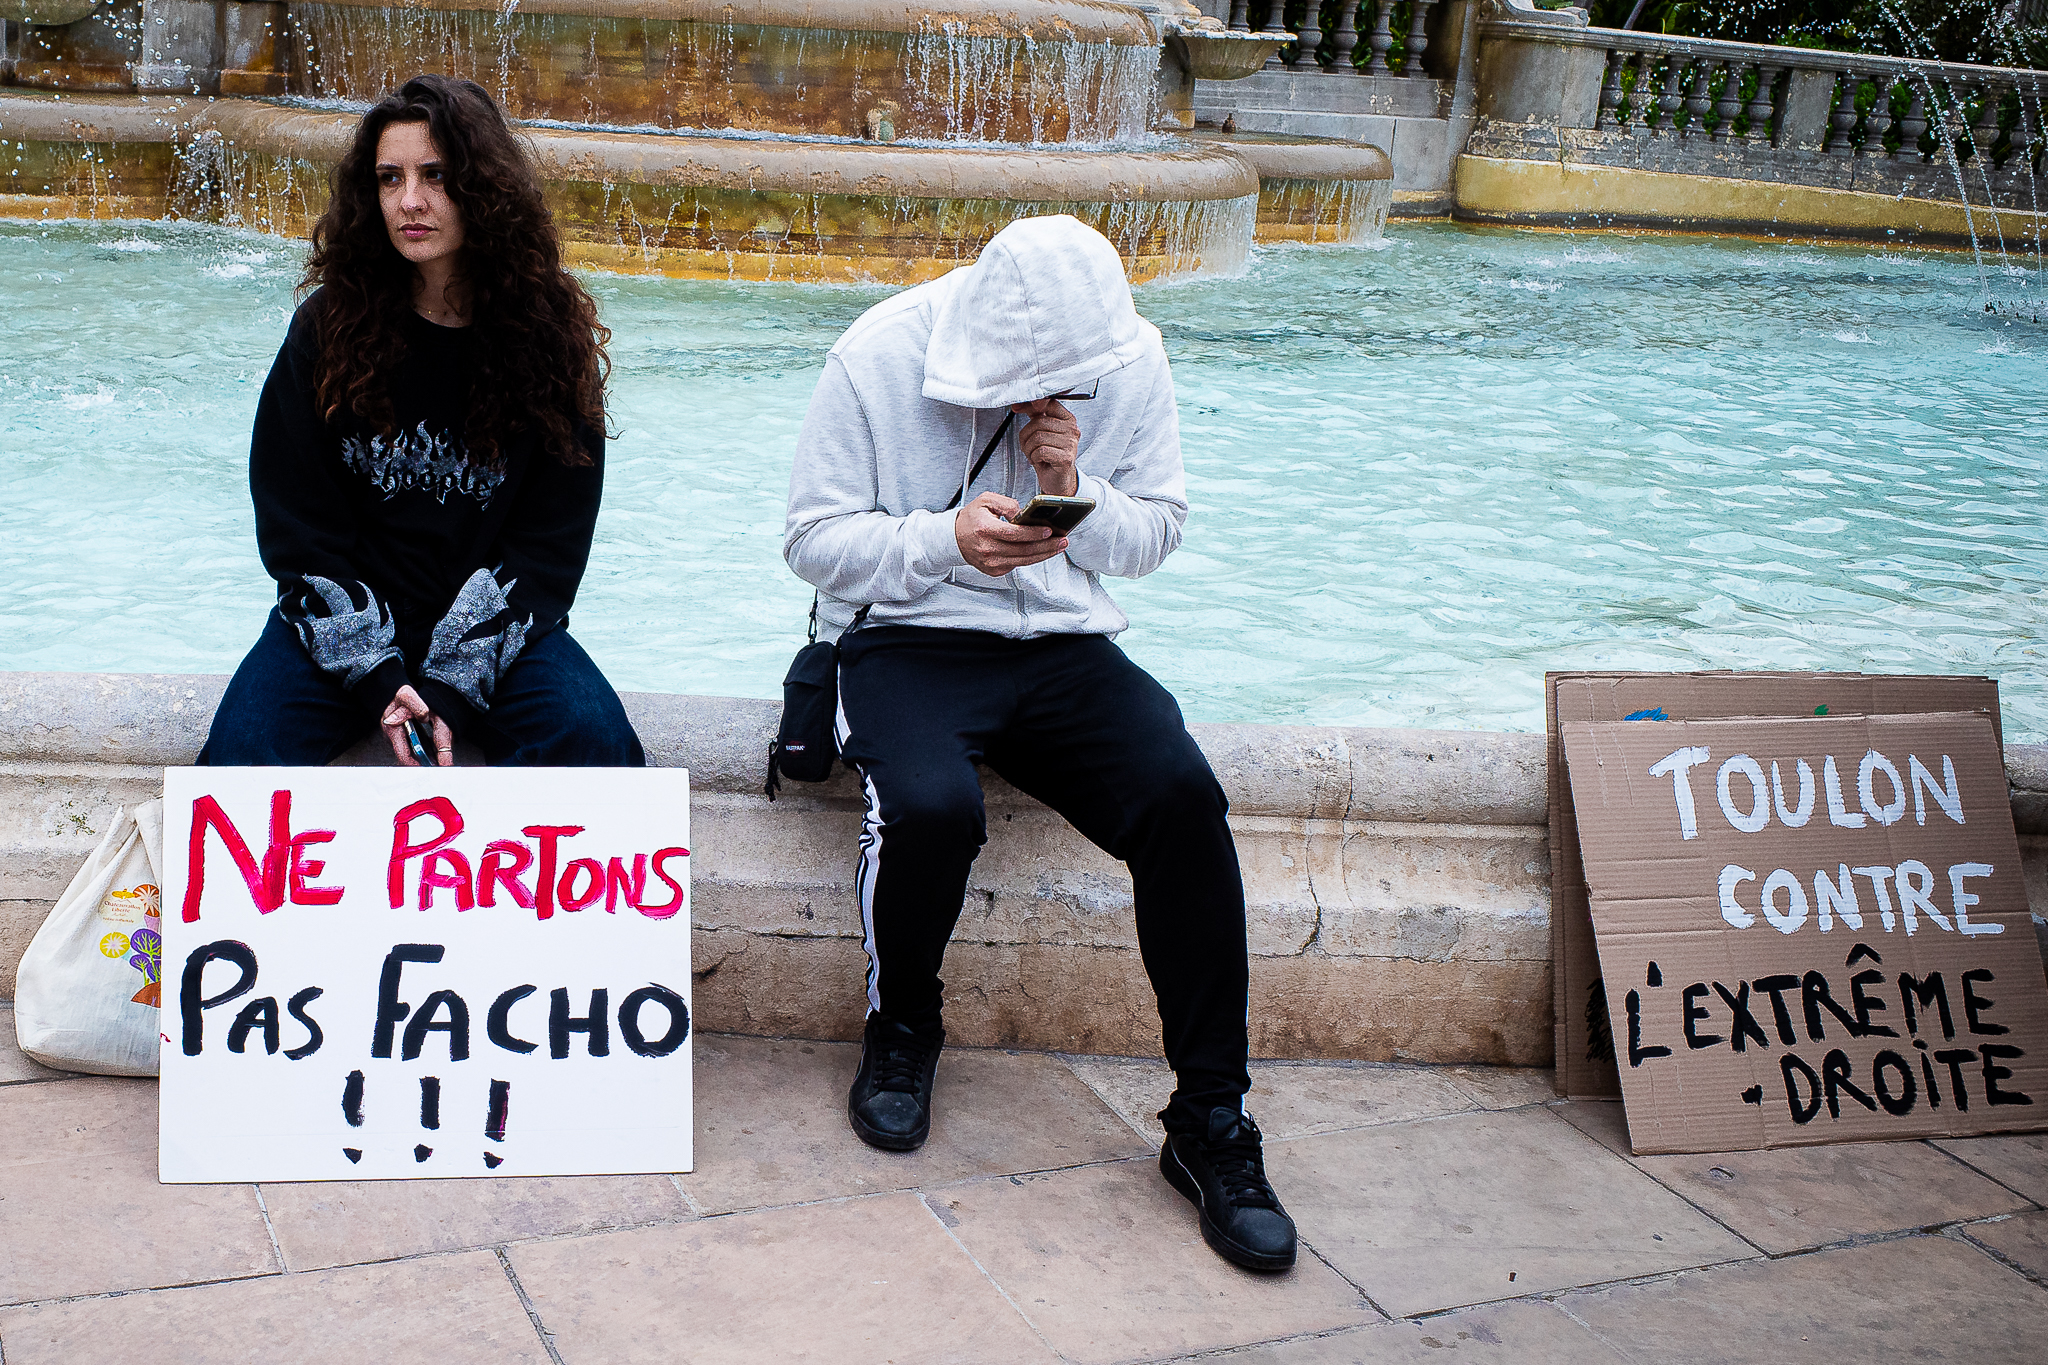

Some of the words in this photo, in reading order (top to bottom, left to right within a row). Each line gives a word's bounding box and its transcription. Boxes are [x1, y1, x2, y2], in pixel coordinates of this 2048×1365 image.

[1648, 745, 1966, 840] TOULON
[181, 789, 345, 923] NE
[387, 796, 690, 920] PARTONS
[1717, 859, 2005, 938] CONTRE
[180, 939, 324, 1061] PAS
[370, 943, 690, 1062] FACHO
[1625, 943, 2010, 1067] L'EXTRÊME
